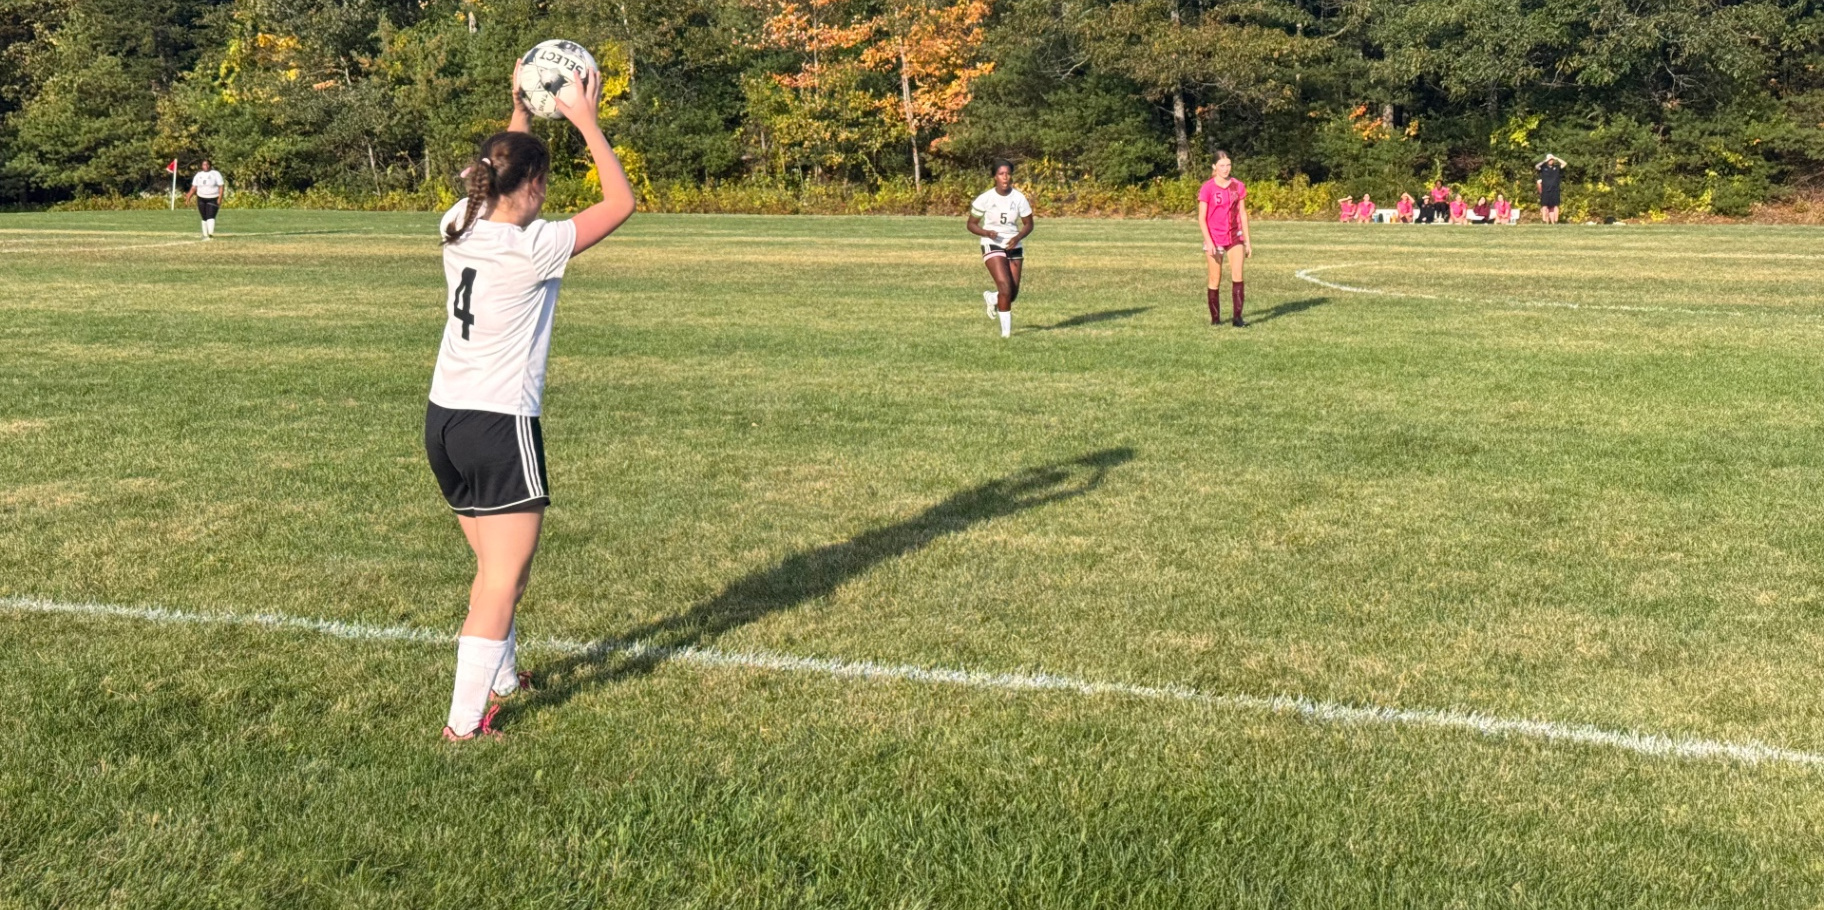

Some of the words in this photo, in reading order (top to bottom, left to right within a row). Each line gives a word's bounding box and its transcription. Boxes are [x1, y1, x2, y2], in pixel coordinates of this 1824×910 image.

[540, 50, 583, 75] SELECT
[1215, 192, 1223, 205] 5
[1000, 212, 1007, 225] 5
[453, 267, 477, 341] 4
